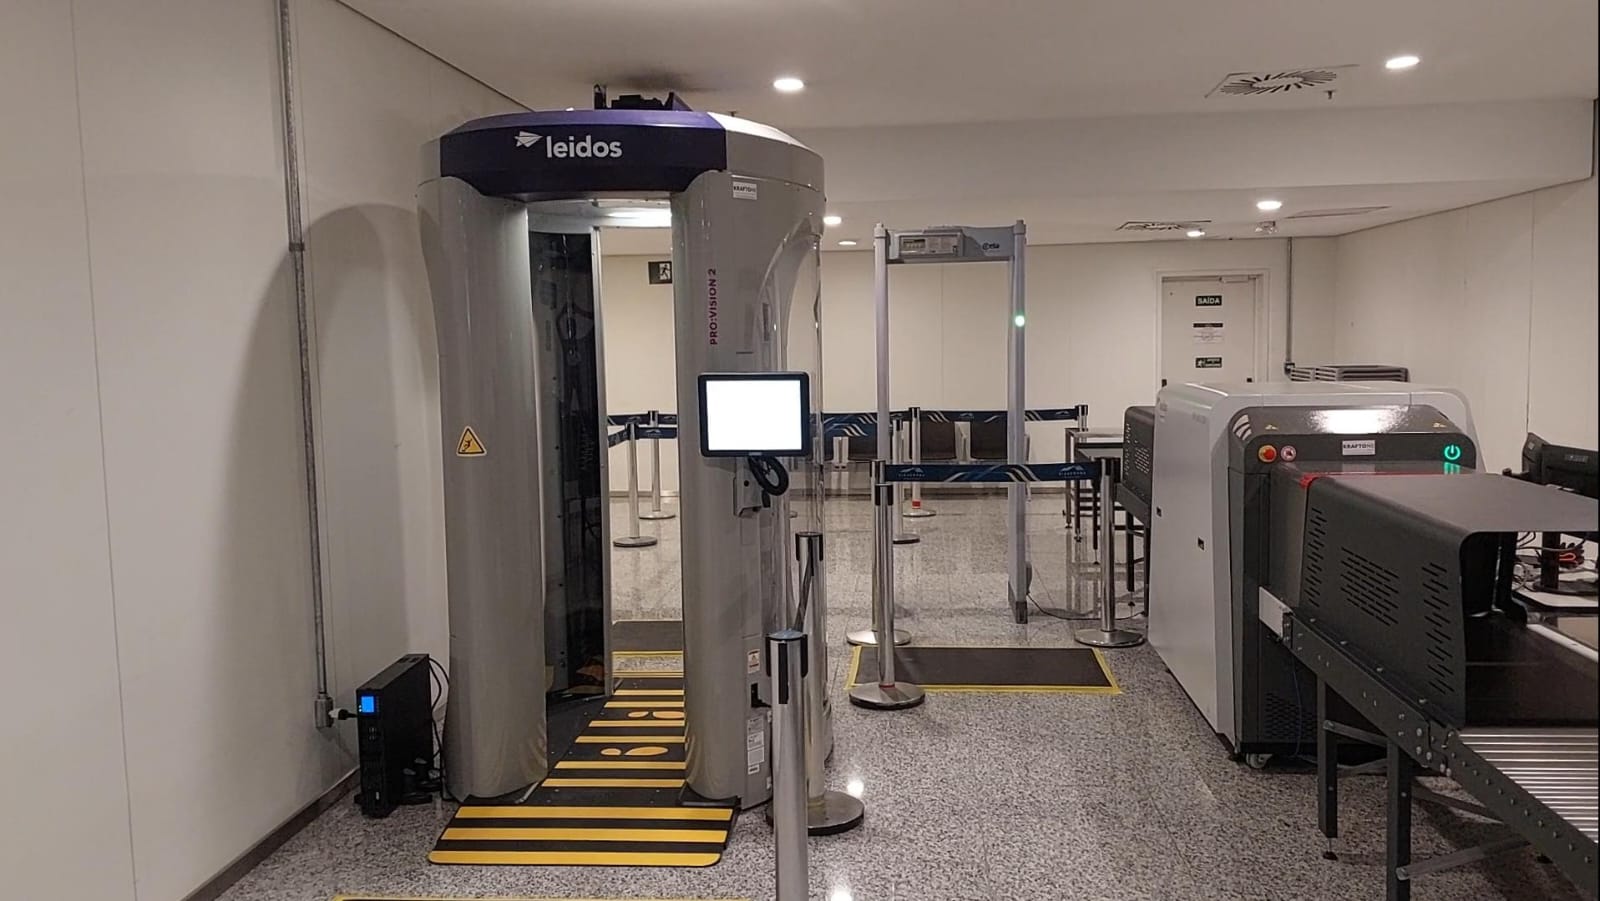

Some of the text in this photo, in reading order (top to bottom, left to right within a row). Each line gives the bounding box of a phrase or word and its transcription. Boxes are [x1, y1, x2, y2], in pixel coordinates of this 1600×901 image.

[546, 134, 623, 158] leidos
[708, 268, 718, 345] PRO:VISION 2
